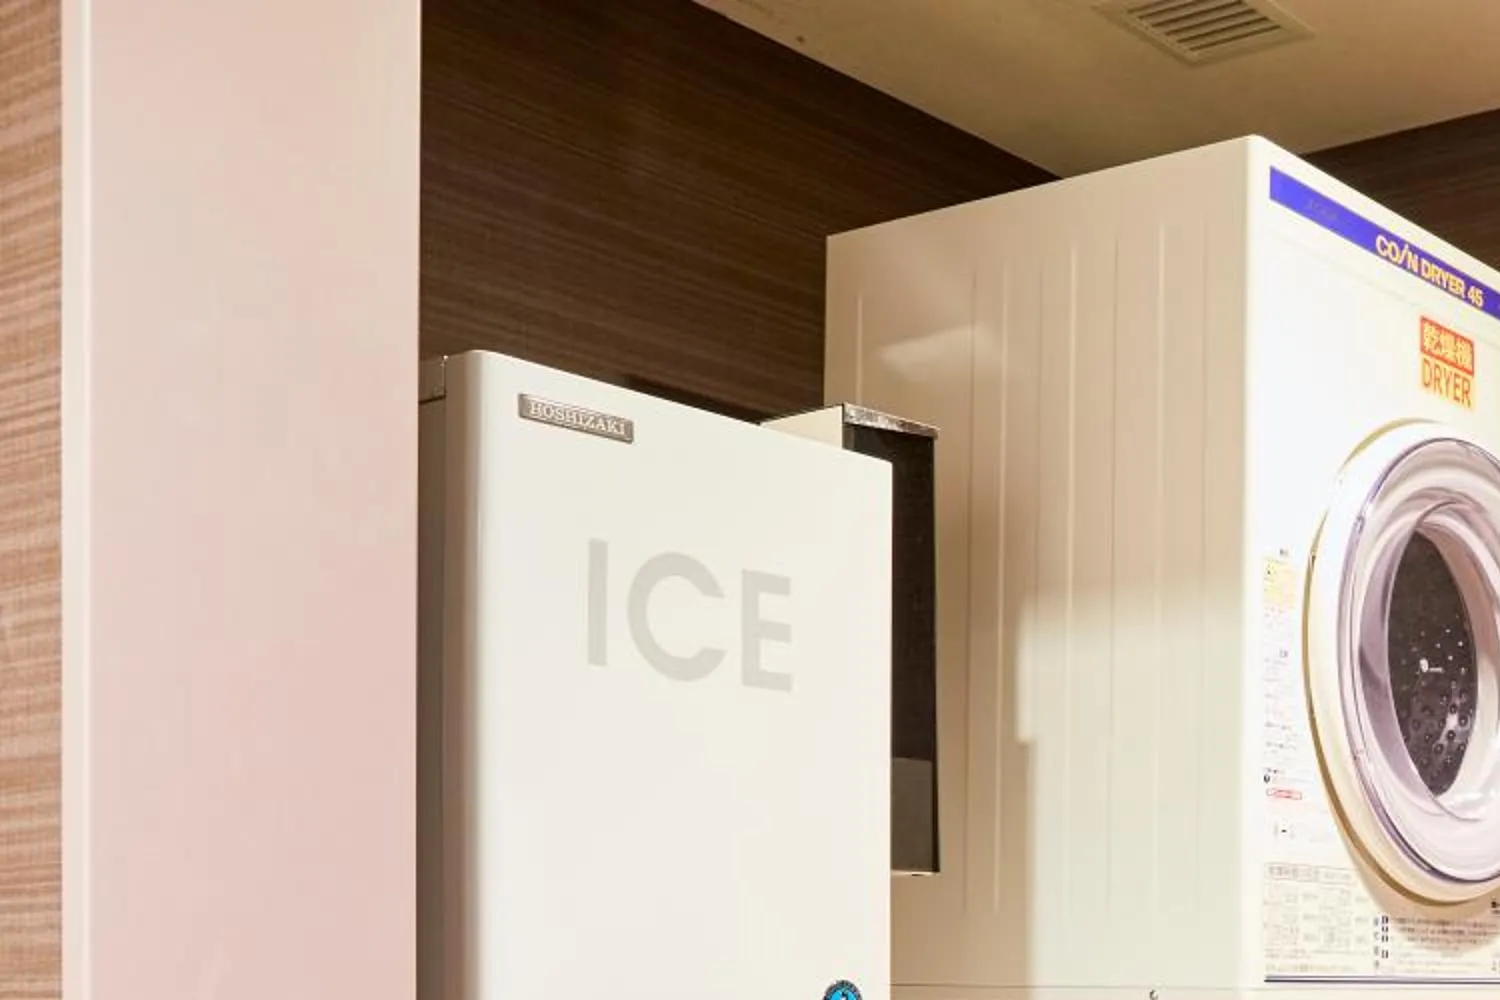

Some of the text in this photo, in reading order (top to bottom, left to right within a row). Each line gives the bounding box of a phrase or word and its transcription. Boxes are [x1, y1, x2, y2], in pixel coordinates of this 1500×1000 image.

[1420, 258, 1466, 299] DRYER
[1467, 286, 1484, 307] 45
[1422, 357, 1472, 409] DRYER
[527, 401, 626, 436] HOSHIZAKI
[586, 537, 792, 693] ICE
